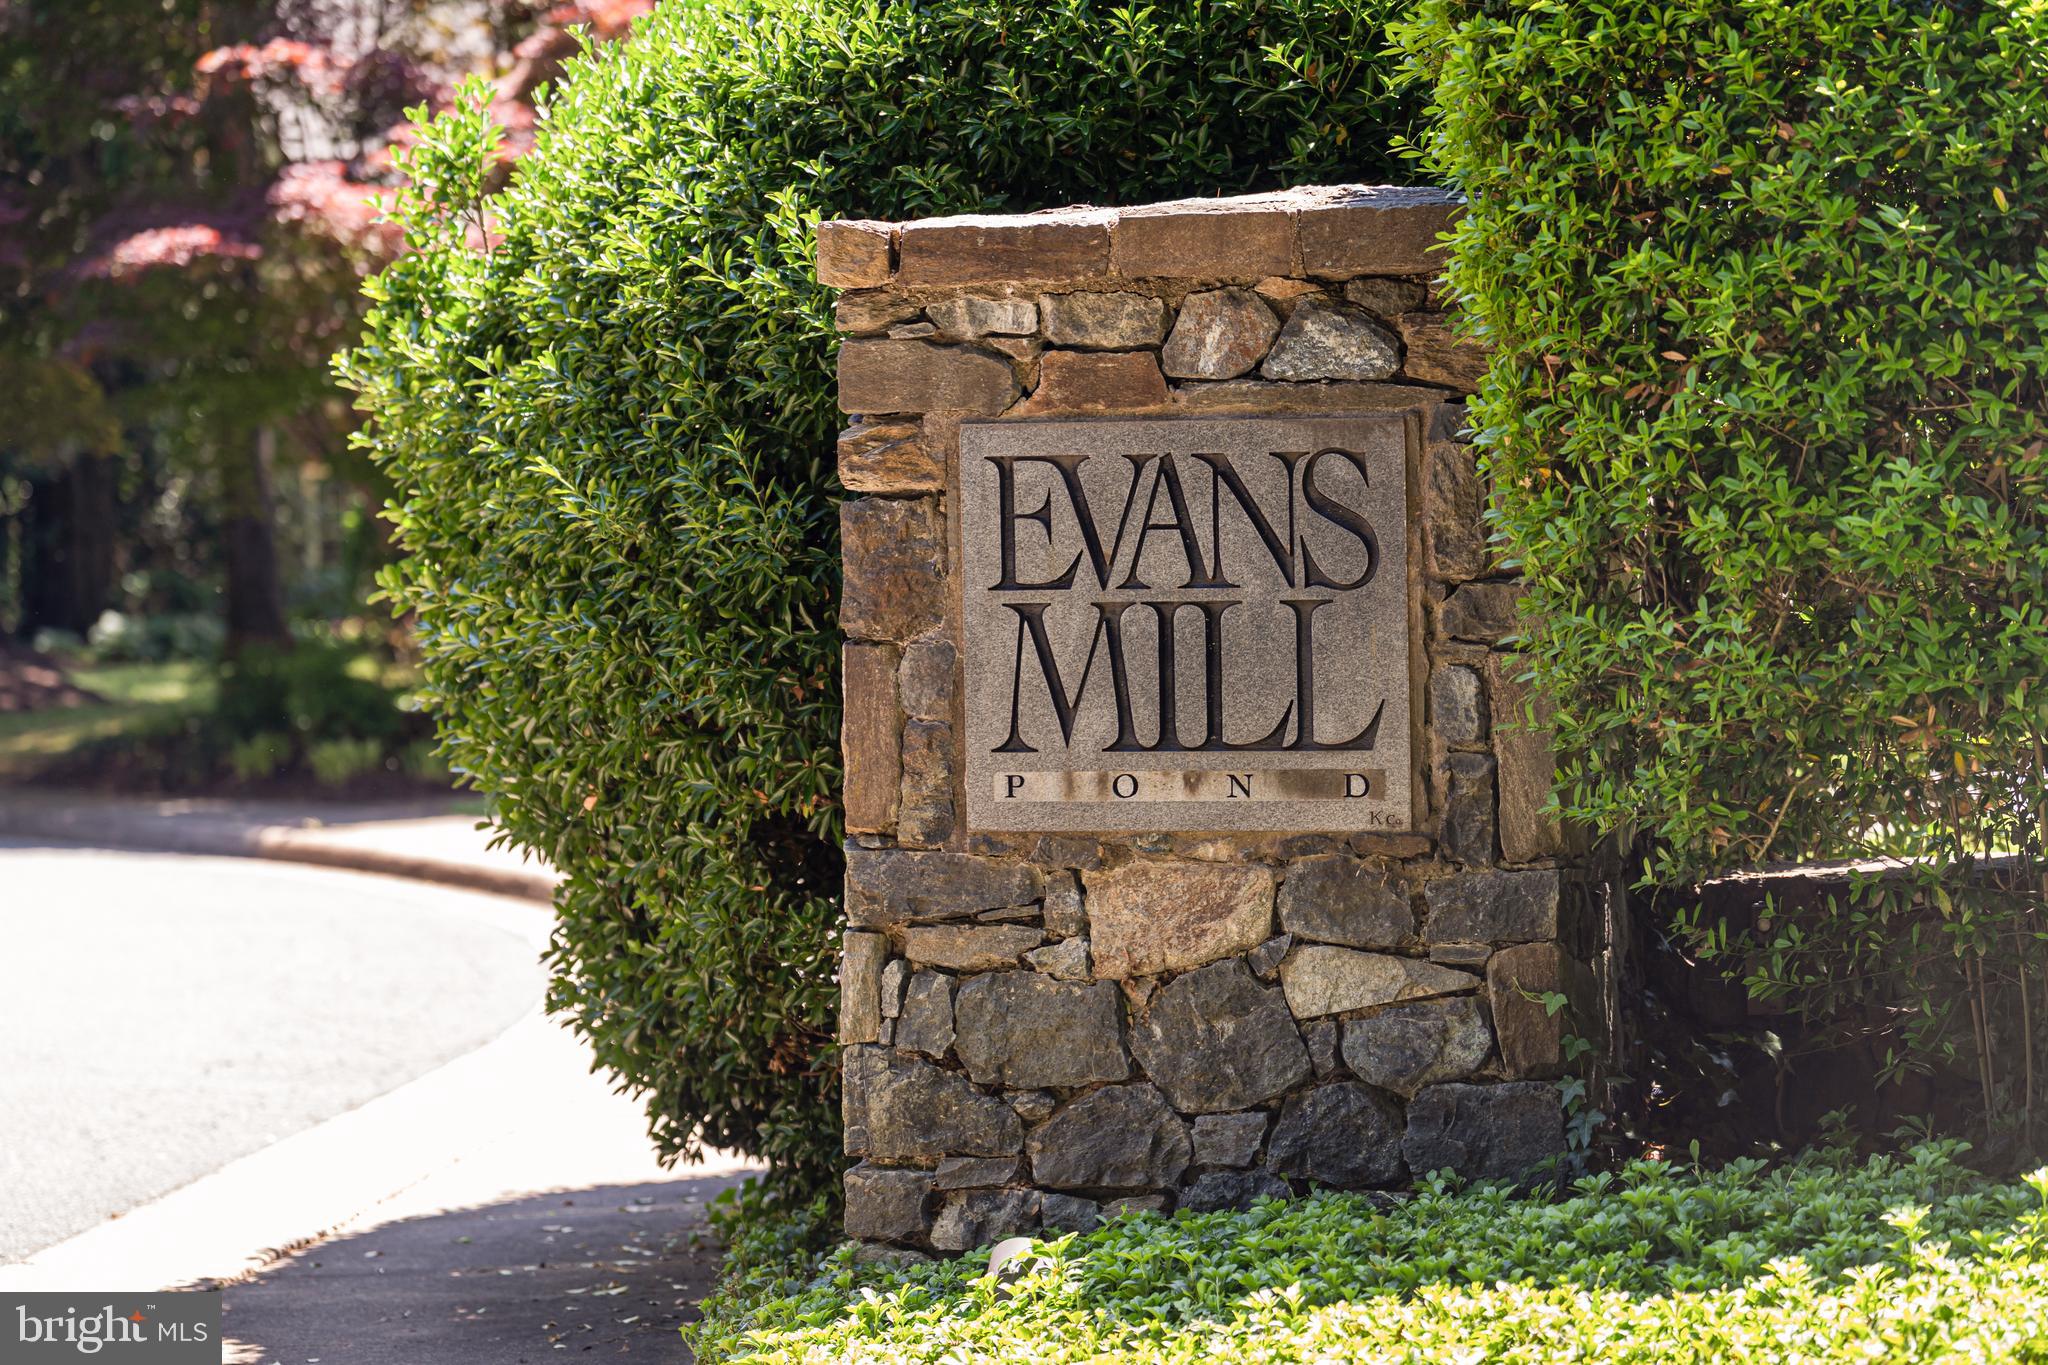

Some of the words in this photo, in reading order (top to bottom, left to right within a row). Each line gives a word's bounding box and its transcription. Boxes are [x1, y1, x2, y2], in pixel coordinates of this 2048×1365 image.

[983, 446, 1380, 591] EVANS
[990, 599, 1386, 752] MILL
[1004, 773, 1371, 799] POND
